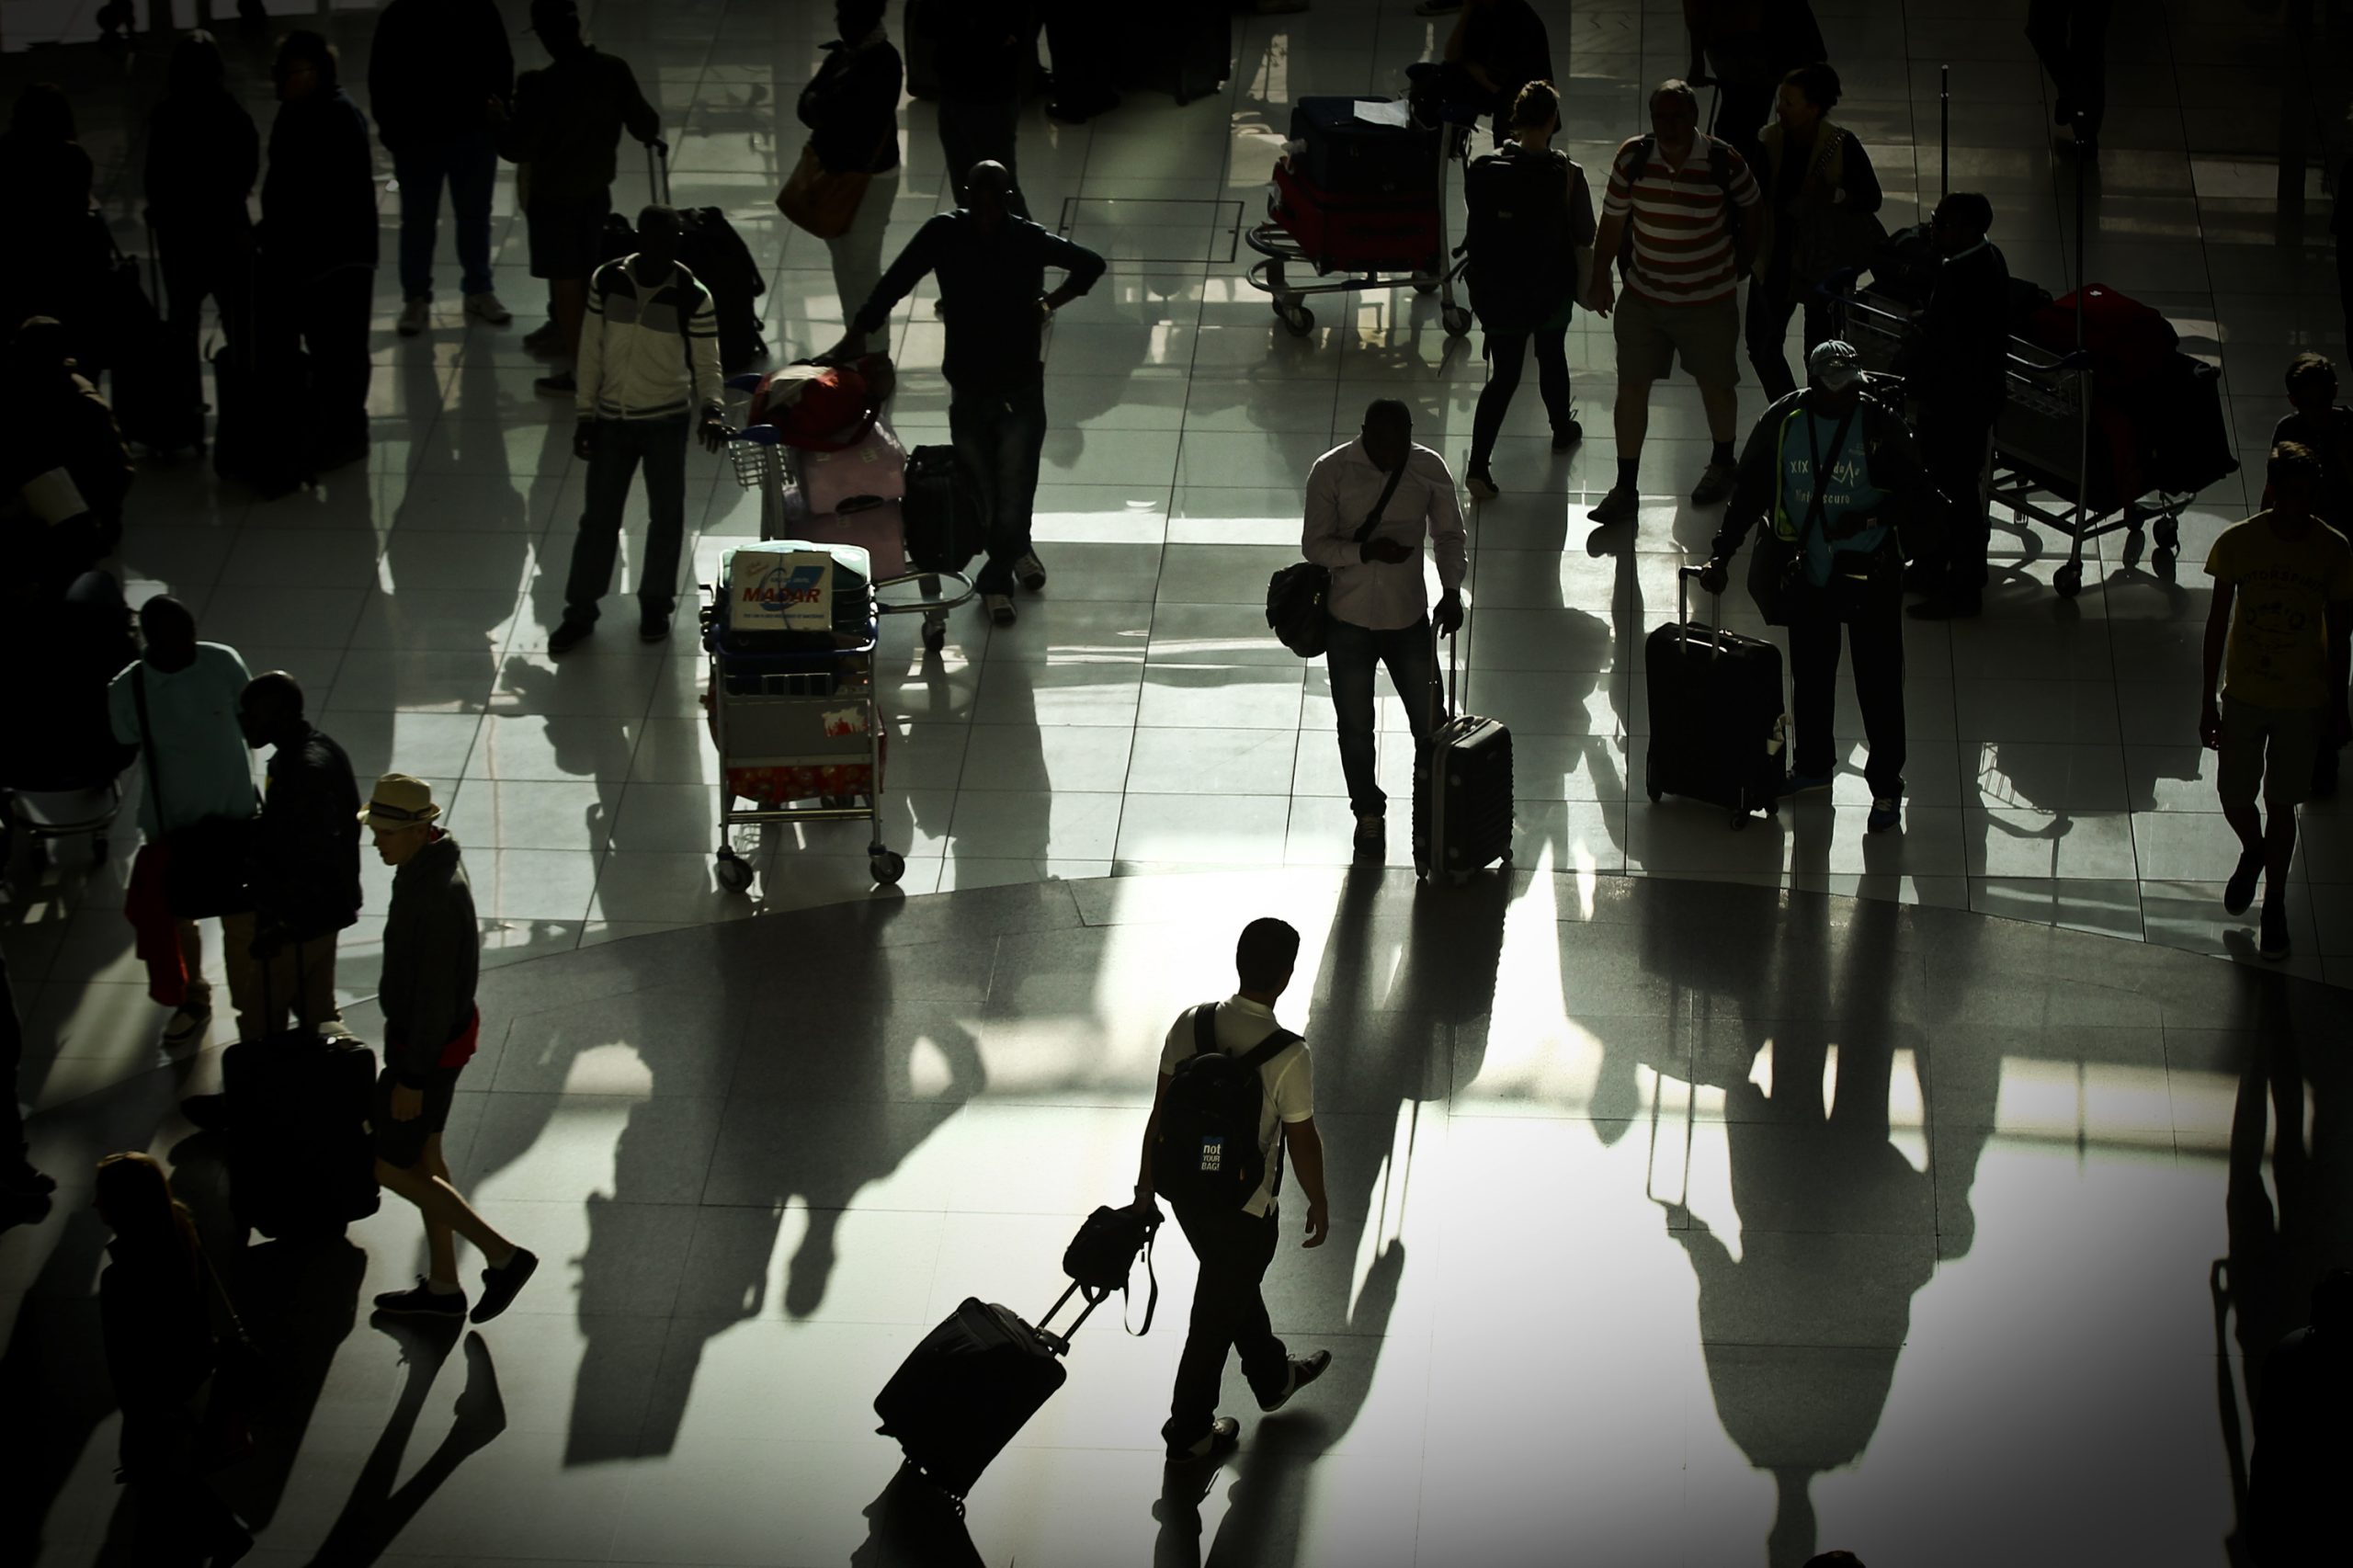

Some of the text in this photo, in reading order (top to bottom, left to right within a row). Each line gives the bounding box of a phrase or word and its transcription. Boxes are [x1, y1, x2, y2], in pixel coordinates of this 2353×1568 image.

[1203, 1143, 1221, 1154] not
[1203, 1154, 1221, 1163] YOUR
[1201, 1162, 1221, 1171] BAG!
